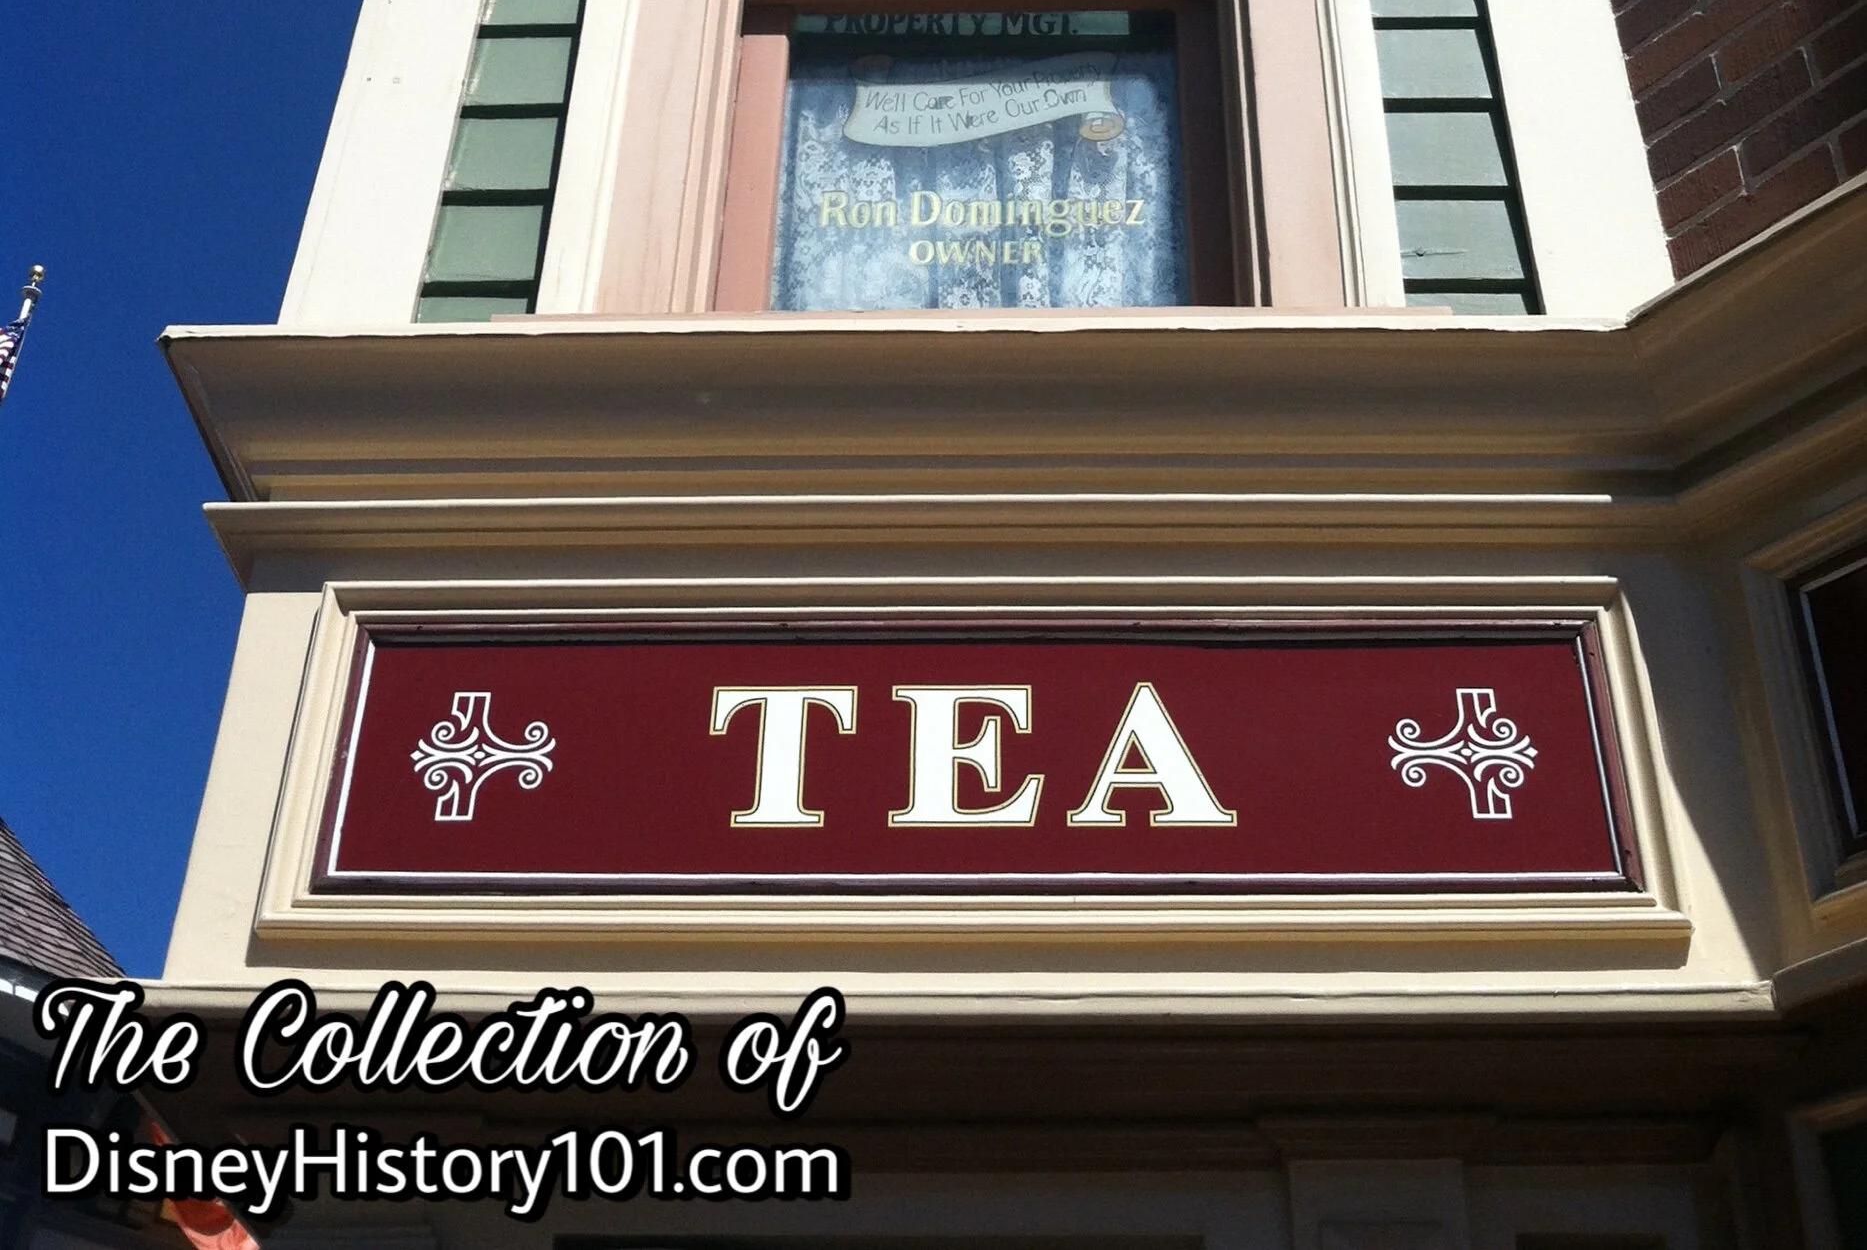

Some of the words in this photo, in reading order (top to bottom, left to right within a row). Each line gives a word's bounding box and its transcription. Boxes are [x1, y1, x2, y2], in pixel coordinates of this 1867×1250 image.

[913, 91, 957, 112] Care
[959, 87, 988, 107] For
[988, 76, 1031, 97] Your
[873, 114, 900, 135] As
[908, 114, 924, 135] If
[930, 114, 943, 134] It
[950, 109, 999, 132] Were
[1004, 98, 1040, 118] Our
[820, 190, 897, 229] Ron
[910, 190, 1146, 238] Dominguez
[908, 239, 1044, 266] OWNER
[709, 680, 1238, 828] TEA
